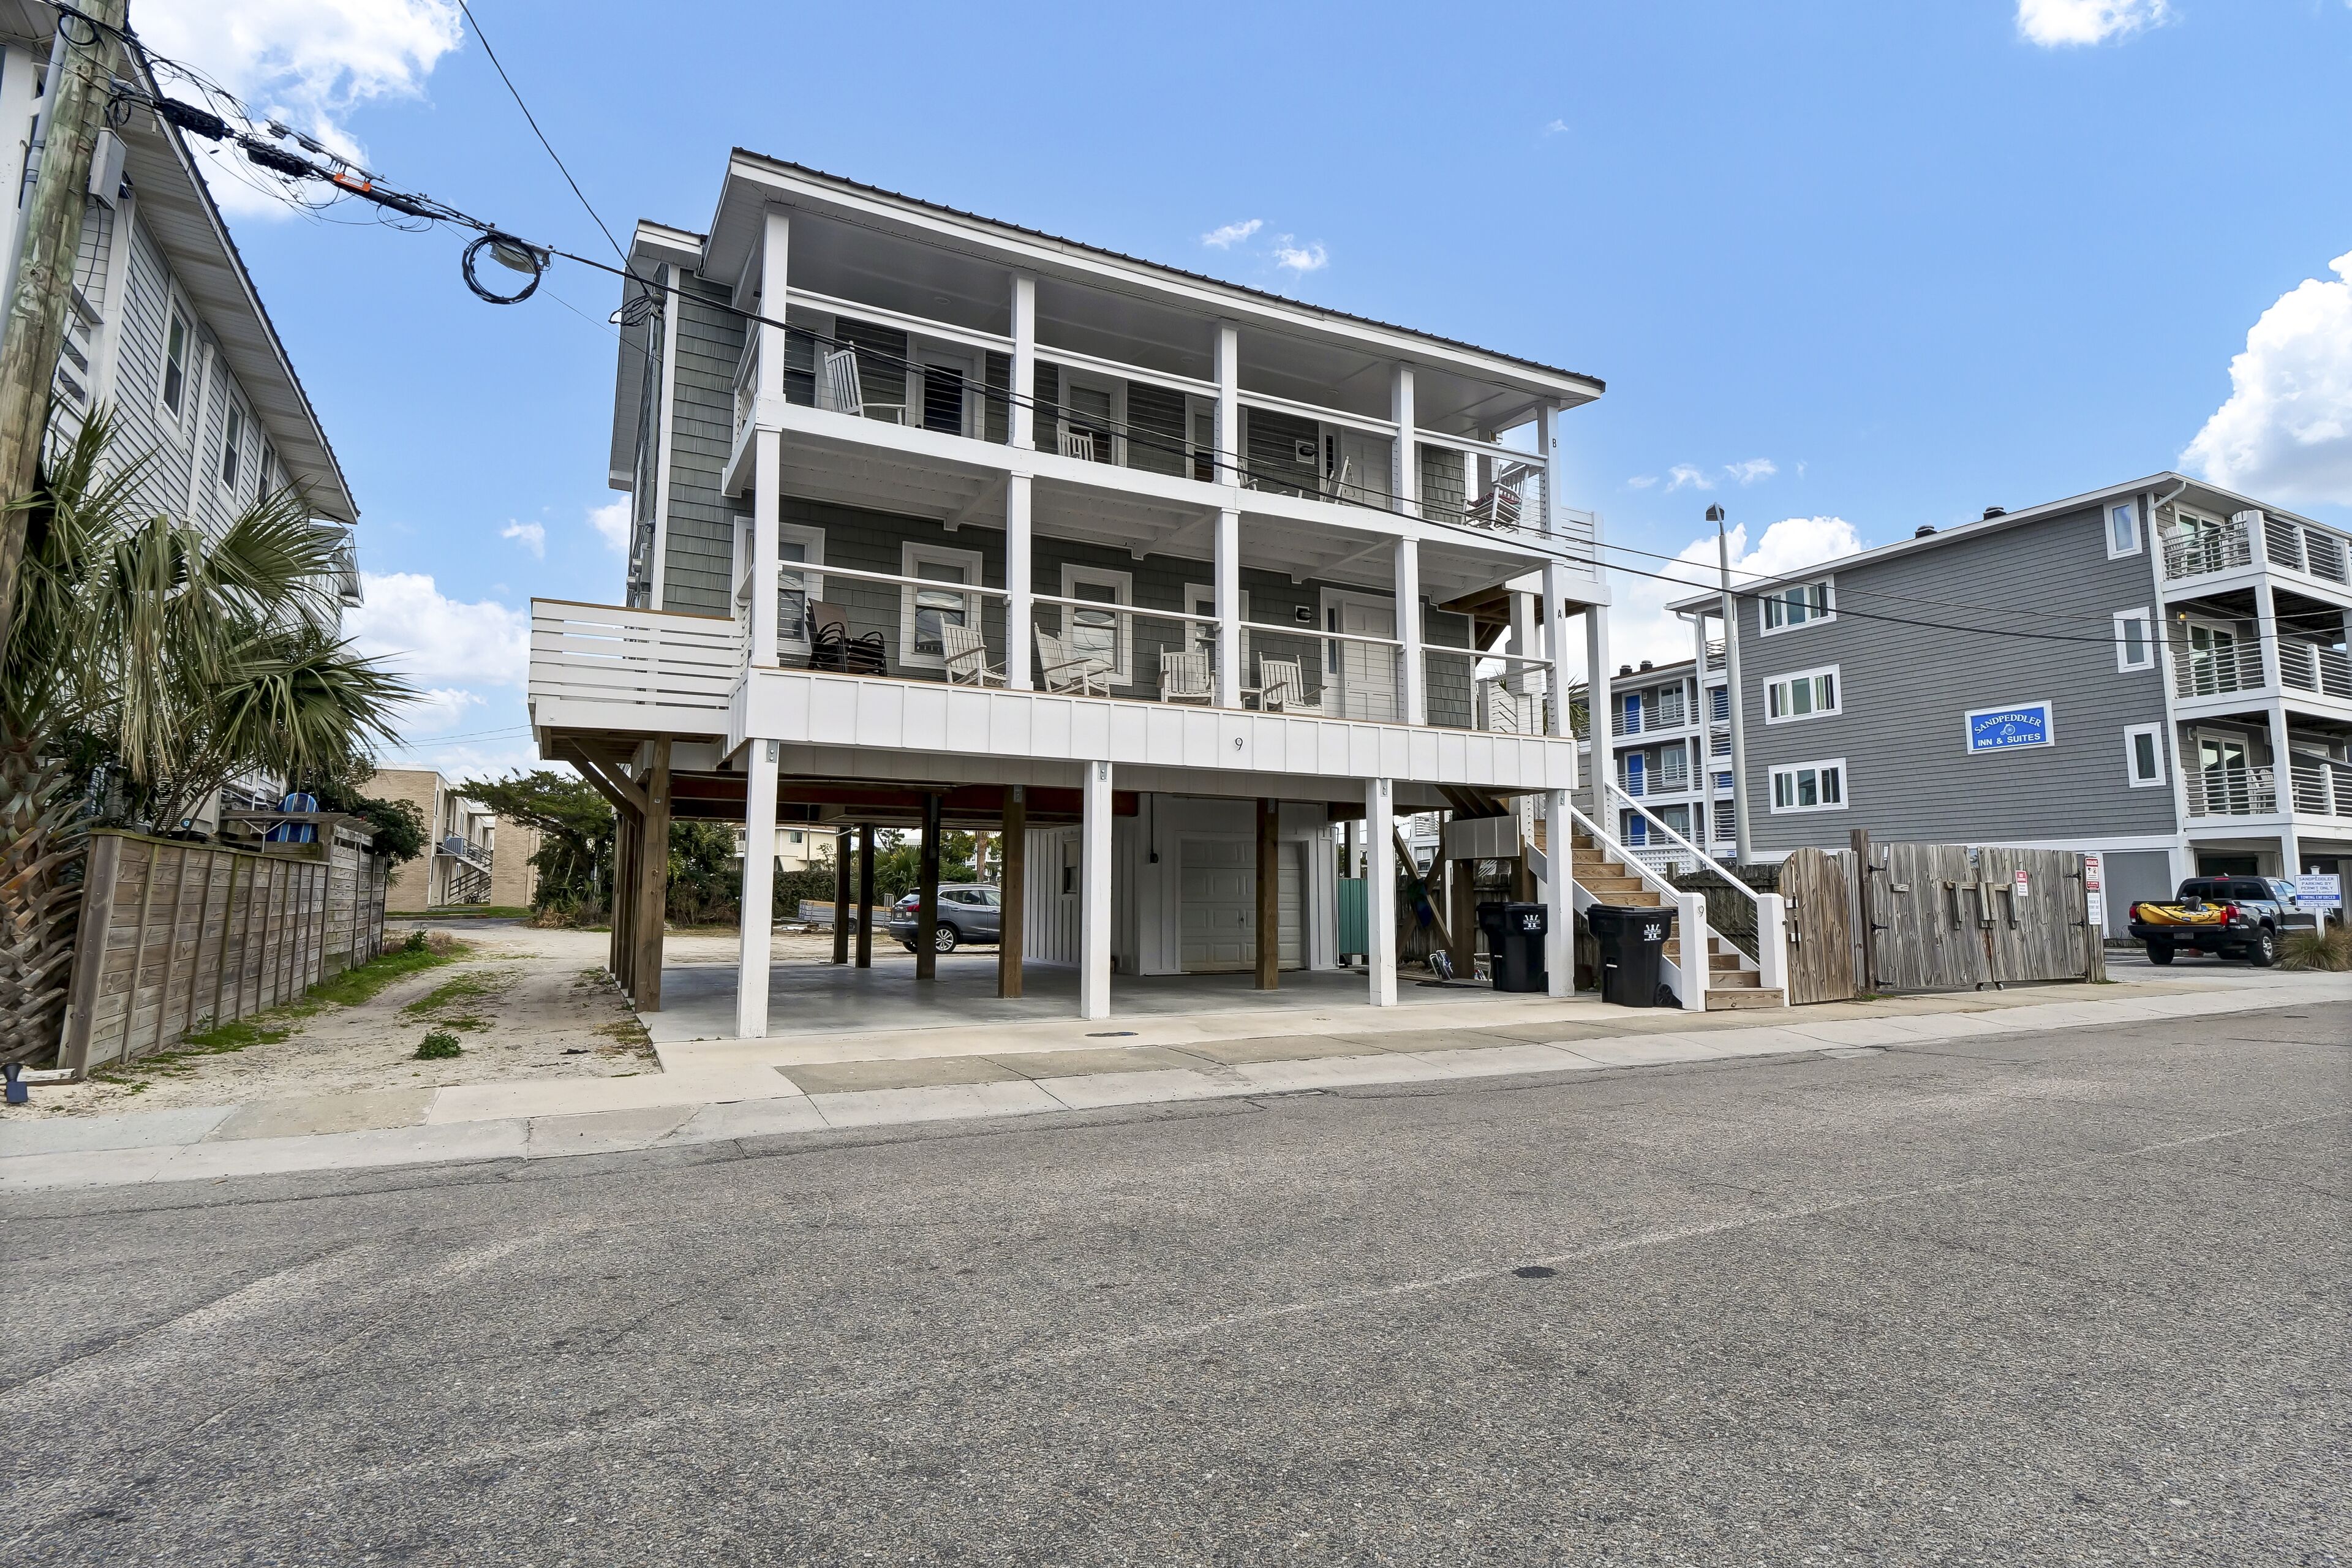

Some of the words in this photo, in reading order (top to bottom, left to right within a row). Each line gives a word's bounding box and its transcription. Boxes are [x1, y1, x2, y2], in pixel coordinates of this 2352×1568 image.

[1552, 438, 1557, 448] B
[1557, 609, 1562, 619] A
[1974, 714, 2042, 734] SANDPEDDLER
[1235, 737, 1243, 751] 9
[1977, 738, 1992, 747] INN
[2007, 733, 2041, 743] SUITES
[1697, 905, 1704, 918] 9
